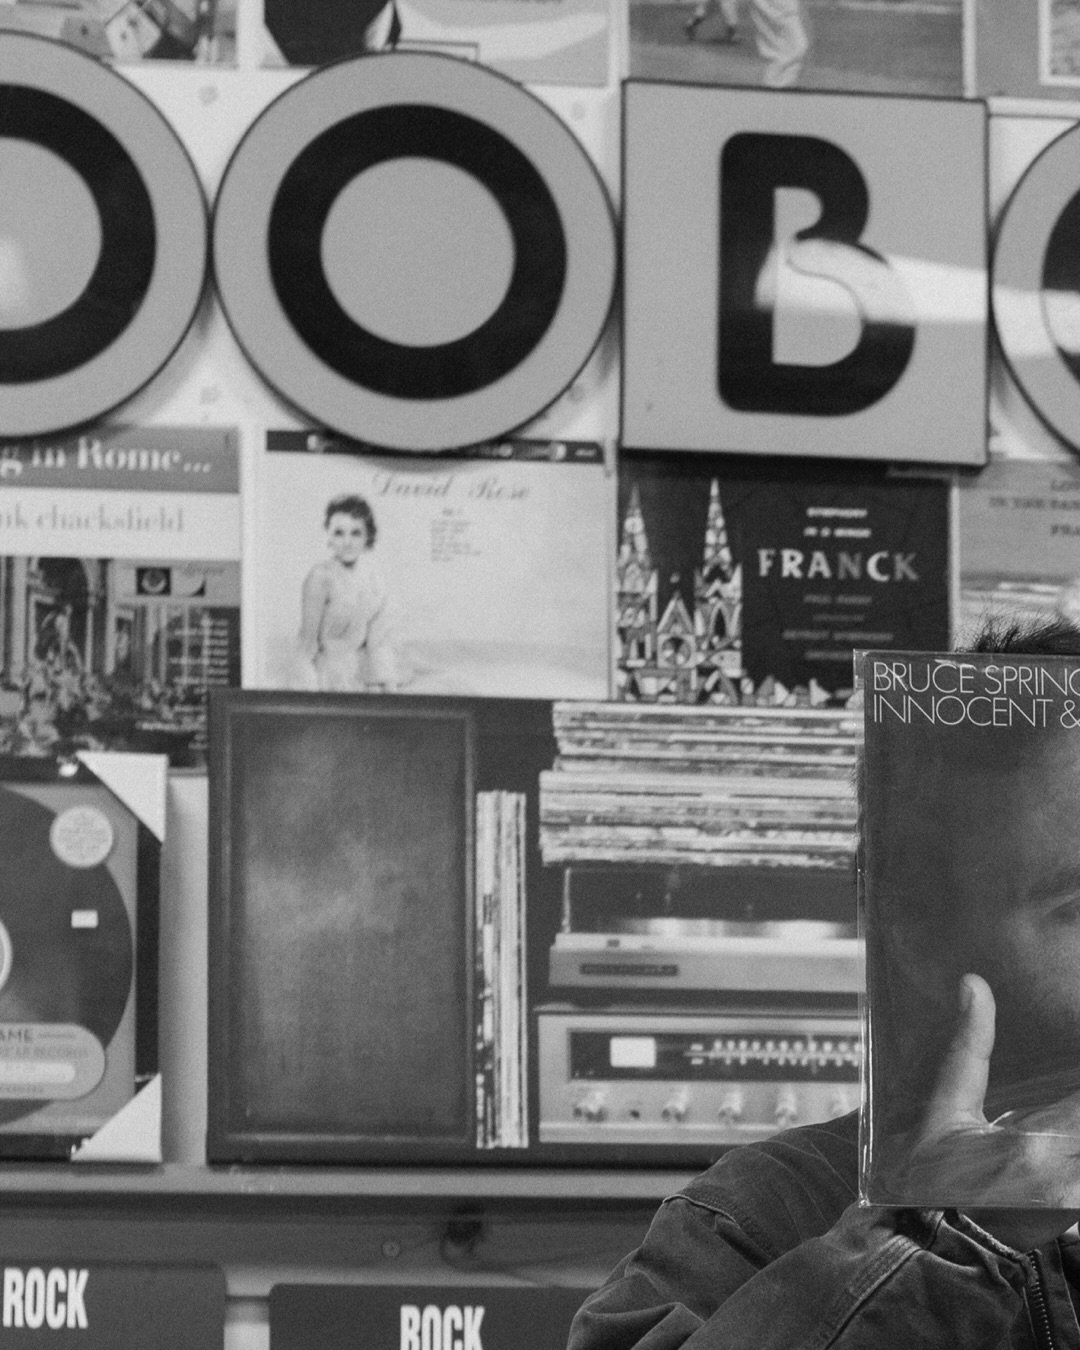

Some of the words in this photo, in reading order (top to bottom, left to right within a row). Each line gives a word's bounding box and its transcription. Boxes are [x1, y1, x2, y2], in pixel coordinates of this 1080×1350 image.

[757, 548, 920, 583] FRANCK
[873, 661, 975, 695] BRUCE
[873, 694, 1054, 728] INNOCENT
[2, 1266, 90, 1330] ROCK
